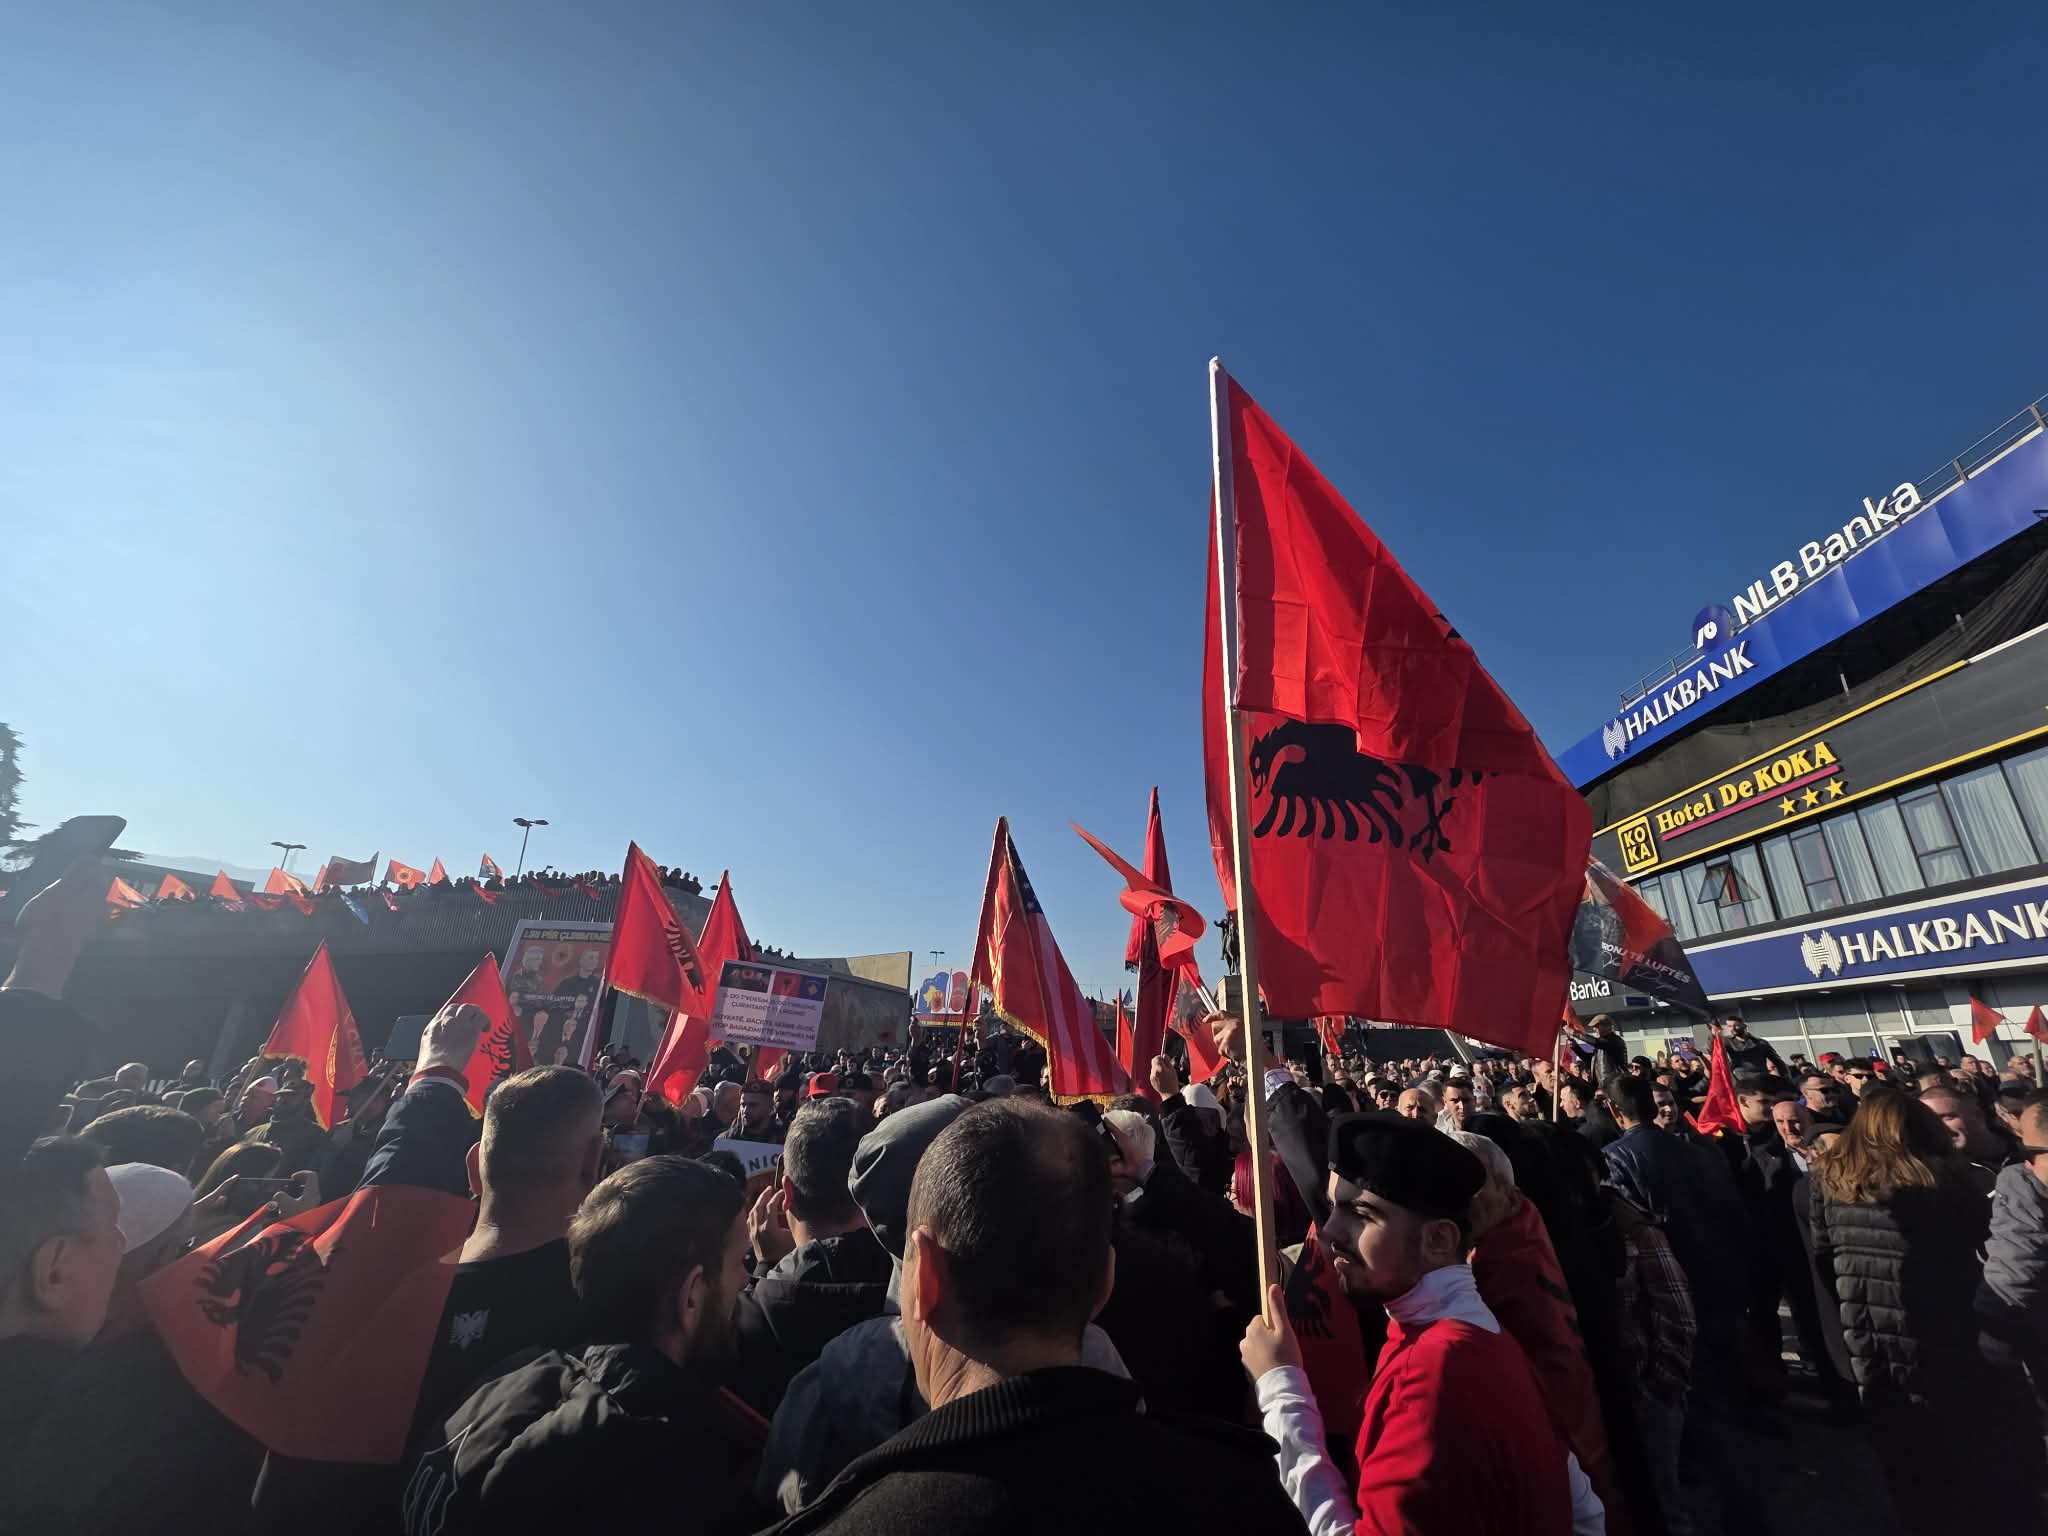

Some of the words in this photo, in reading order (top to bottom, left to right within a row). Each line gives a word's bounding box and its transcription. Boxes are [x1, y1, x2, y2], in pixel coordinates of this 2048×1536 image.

[1732, 560, 1800, 625] NLB
[1799, 482, 1921, 578] Banka
[1624, 641, 1755, 741] HALKBANK
[1655, 793, 1713, 833] Hotel
[1752, 741, 1838, 792] KOKA
[1623, 827, 1644, 847] KO
[1627, 845, 1652, 865] KA
[1841, 903, 2048, 966] HALKBANK
[1570, 976, 1610, 1001] Banka
